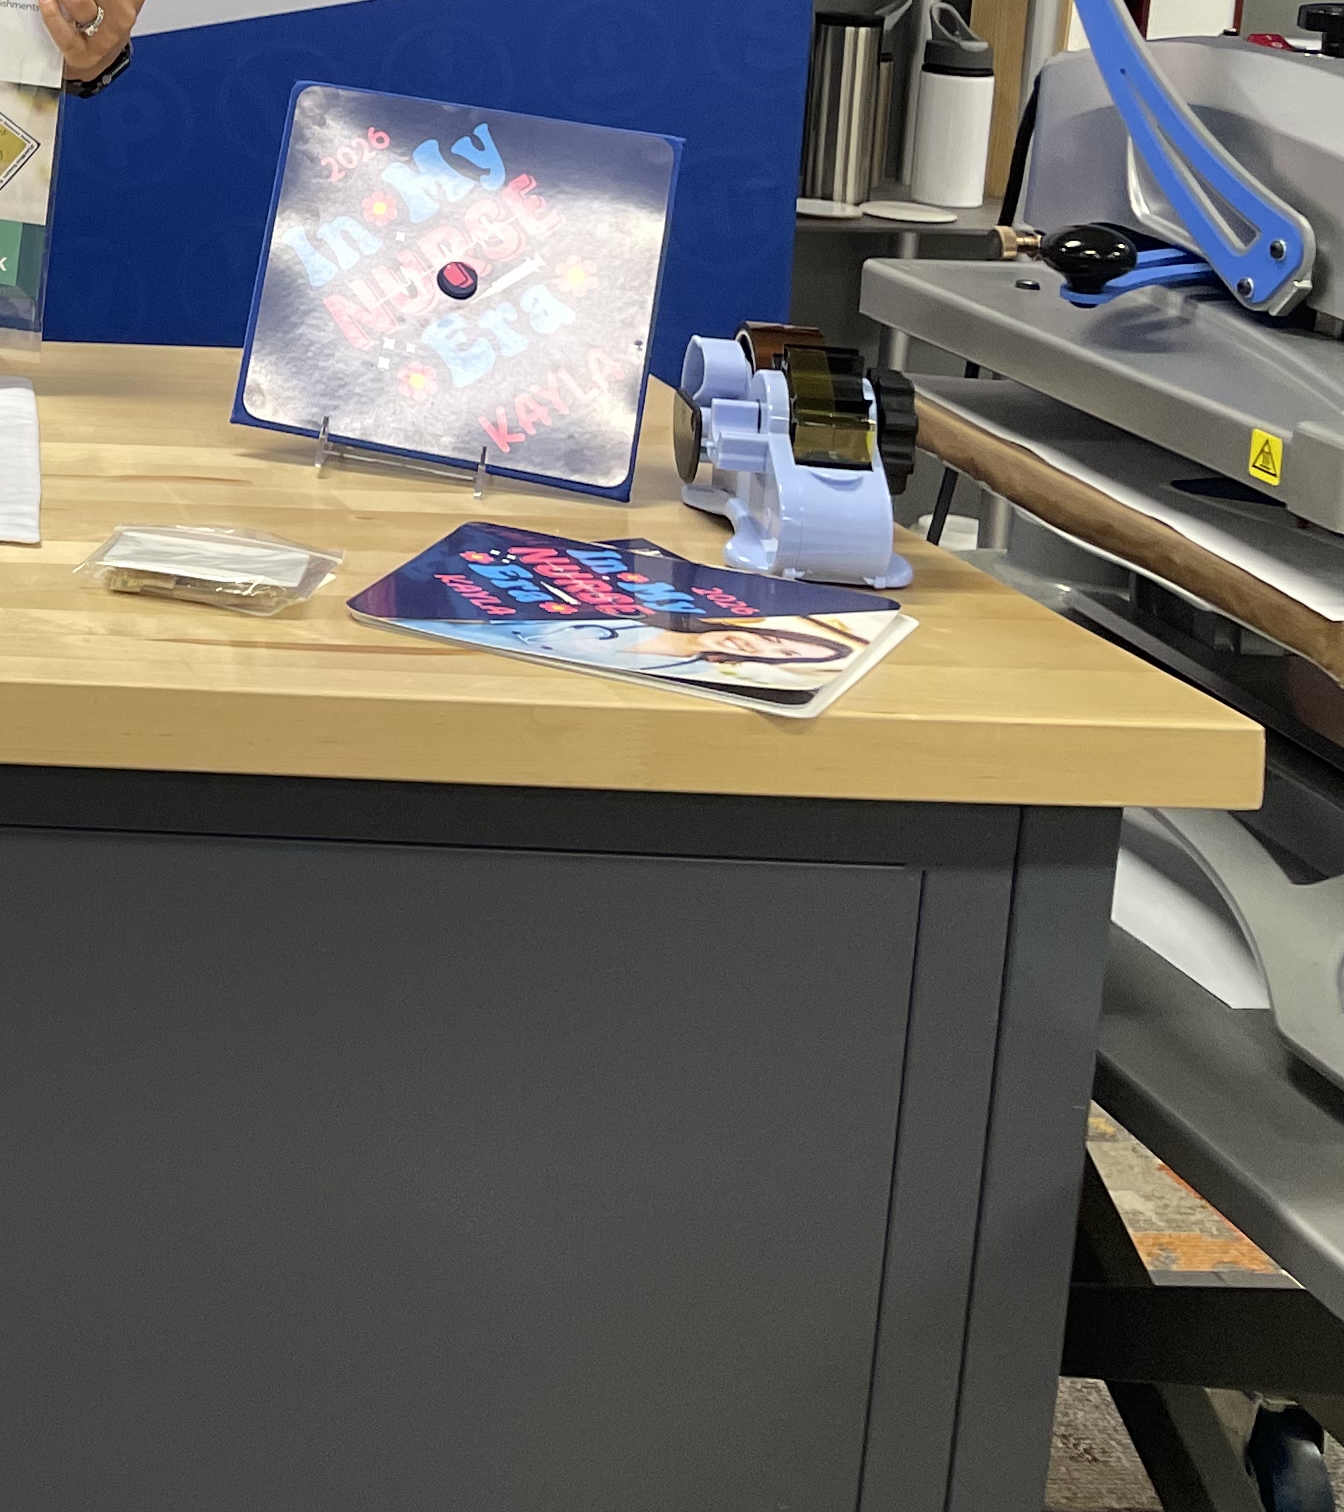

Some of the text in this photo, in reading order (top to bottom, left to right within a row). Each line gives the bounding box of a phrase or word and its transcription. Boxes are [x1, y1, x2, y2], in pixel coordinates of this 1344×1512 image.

[320, 126, 391, 182] 2026
[282, 122, 506, 288] In My
[421, 284, 576, 388] Era
[478, 347, 625, 453] KAYLA
[434, 573, 517, 615] KAYLA
[691, 586, 761, 616] 2026
